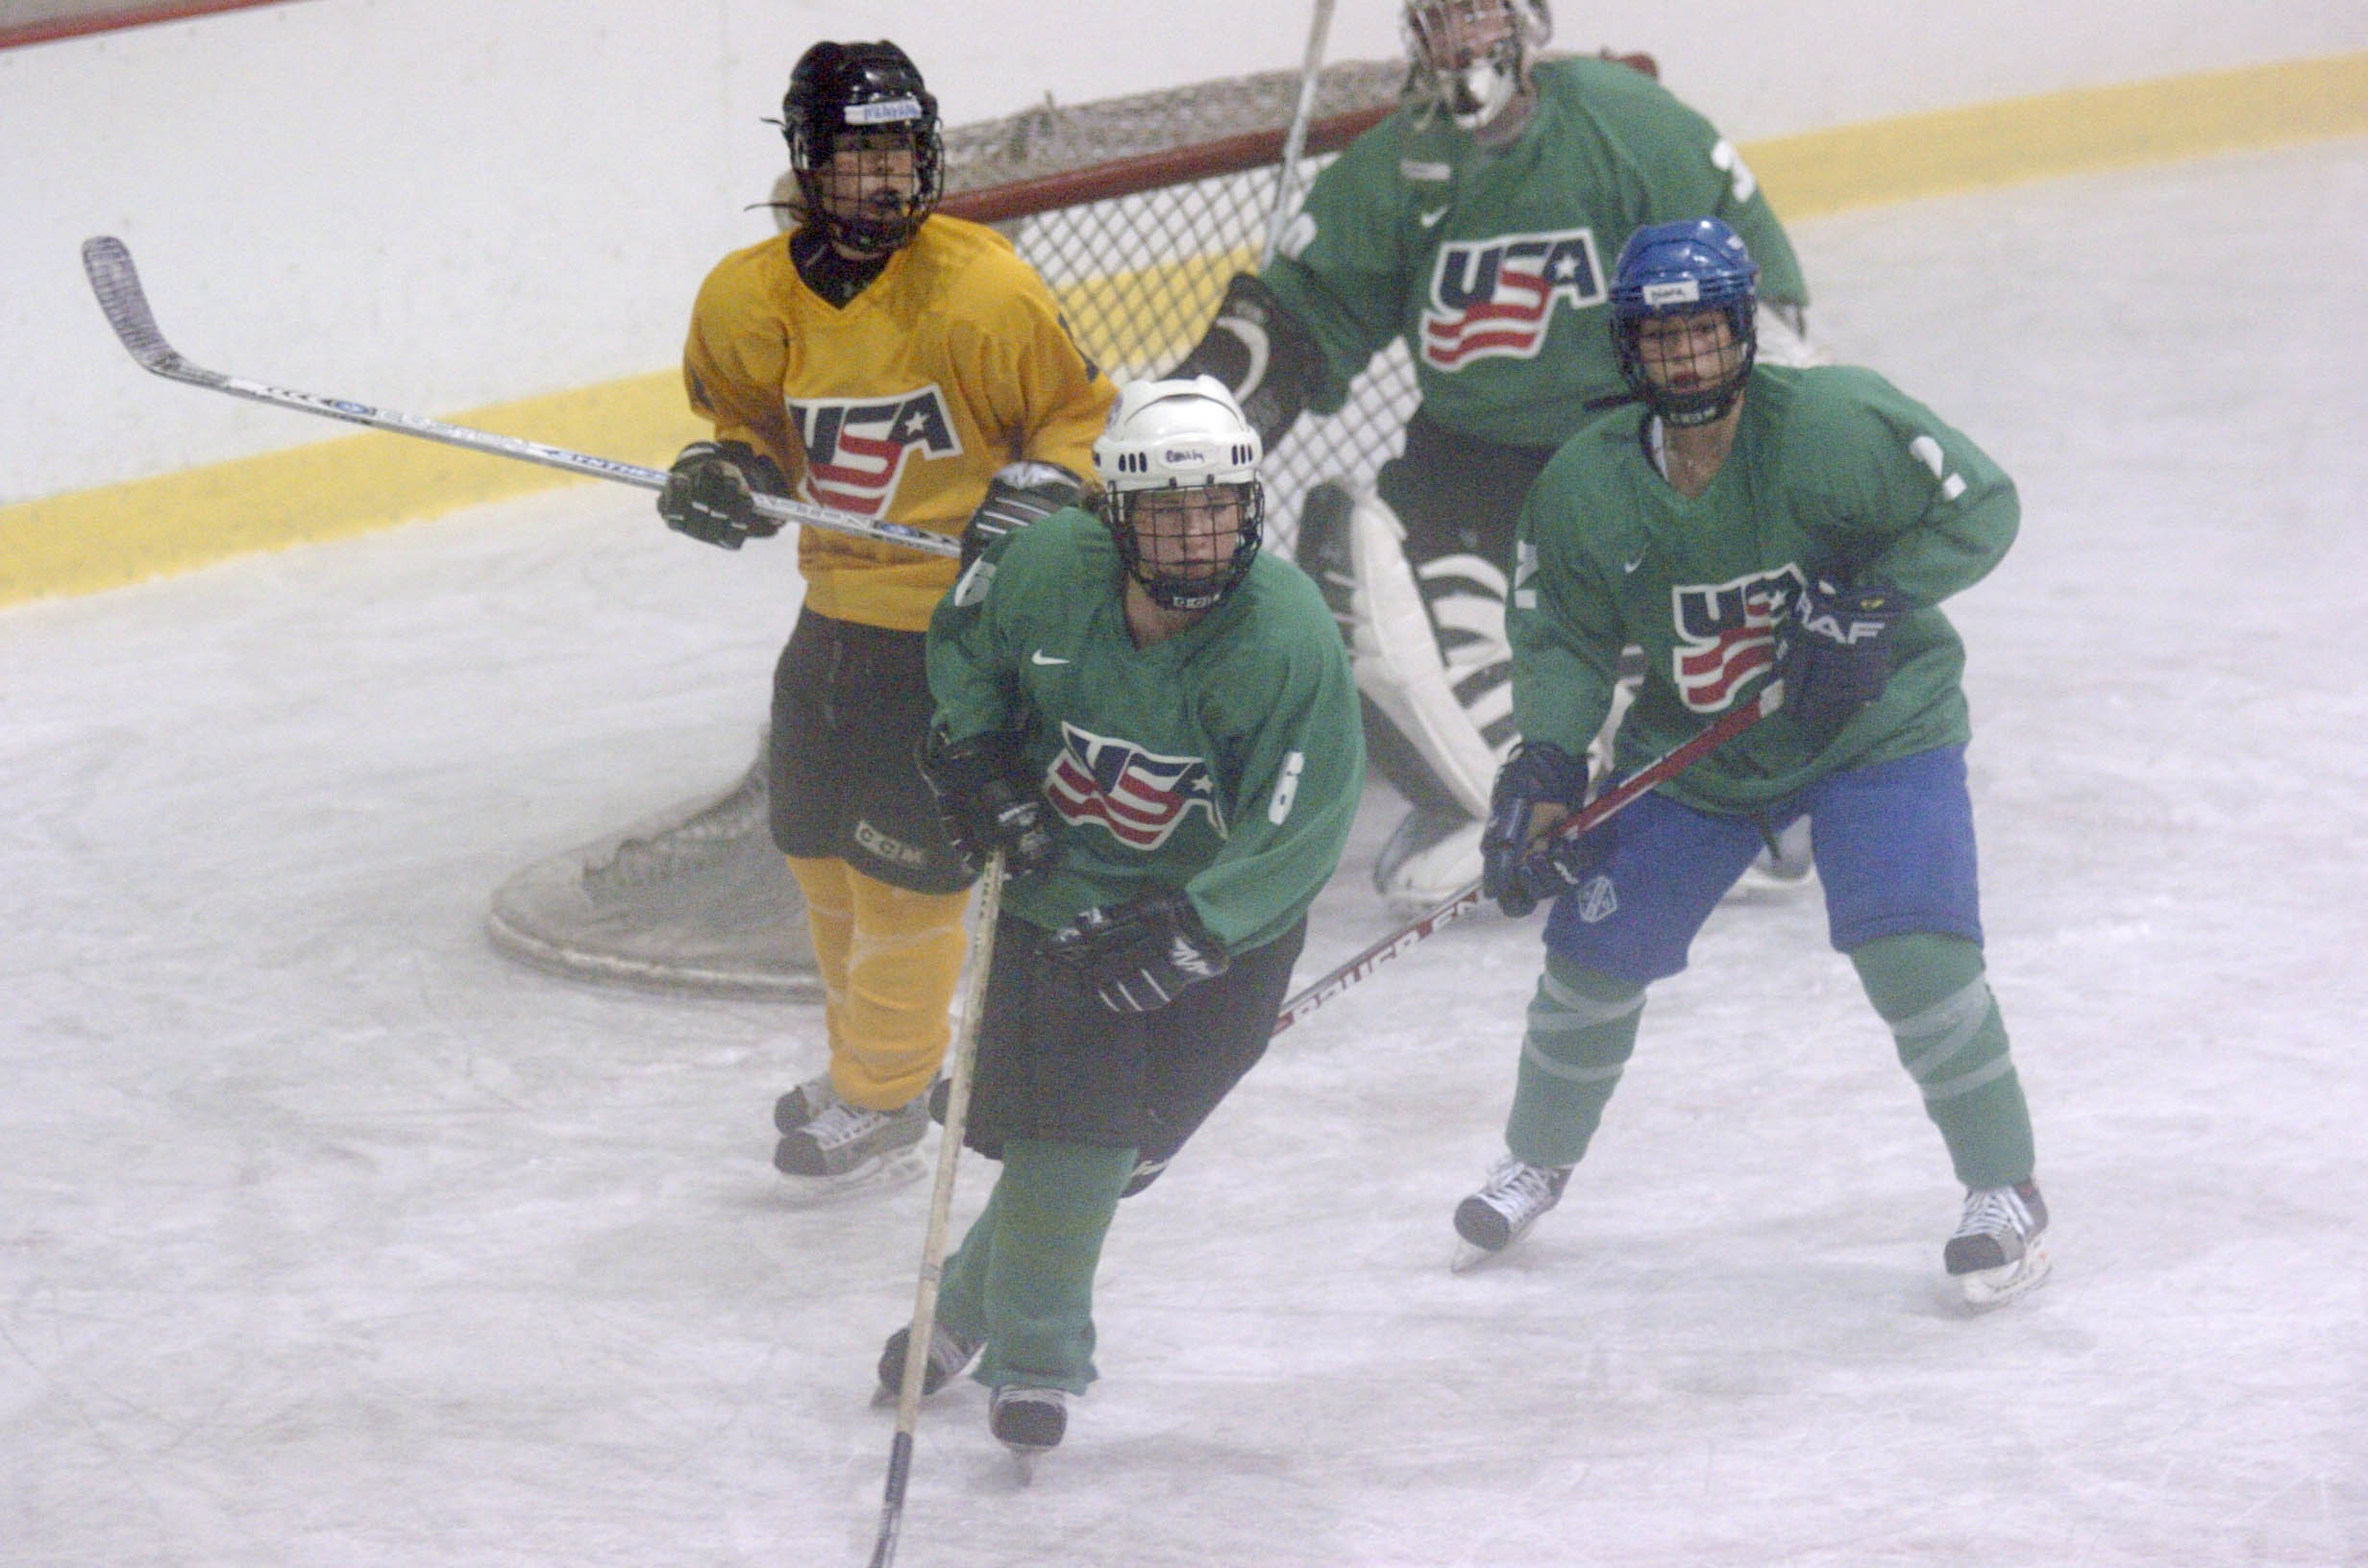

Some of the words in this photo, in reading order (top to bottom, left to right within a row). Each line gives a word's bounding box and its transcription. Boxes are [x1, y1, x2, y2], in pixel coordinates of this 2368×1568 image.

[1422, 229, 1607, 362] USA
[784, 383, 963, 510] USA
[1049, 722, 1228, 845] USA
[1269, 751, 1304, 825] 6
